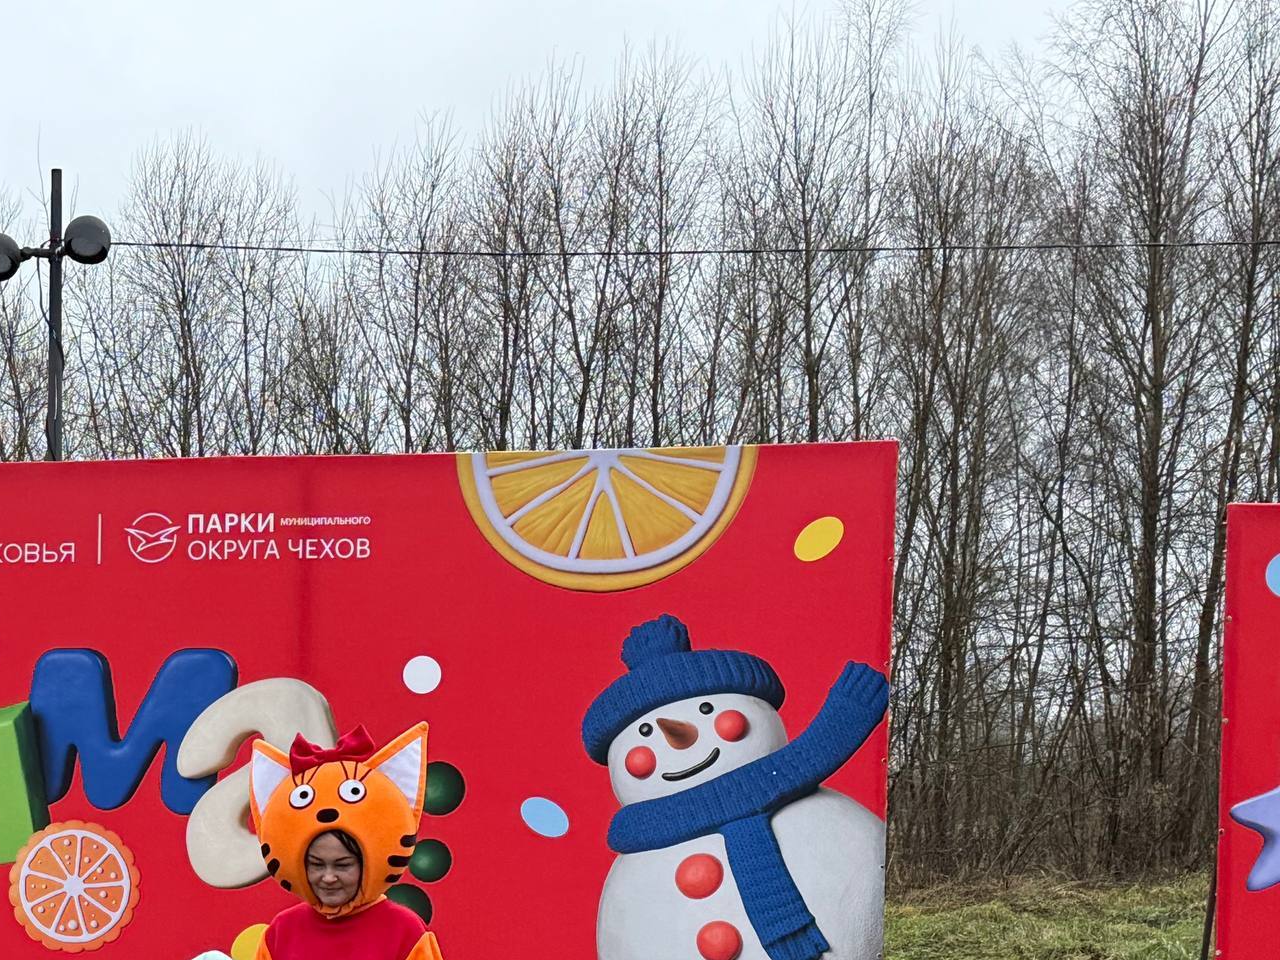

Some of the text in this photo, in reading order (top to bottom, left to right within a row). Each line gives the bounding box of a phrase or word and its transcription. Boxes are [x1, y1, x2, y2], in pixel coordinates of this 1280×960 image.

[187, 512, 371, 534] ПАРКИ МУНИЦИПАЛЬНОГО
[187, 538, 371, 560] ОКРУГА ЧЕХОВ
